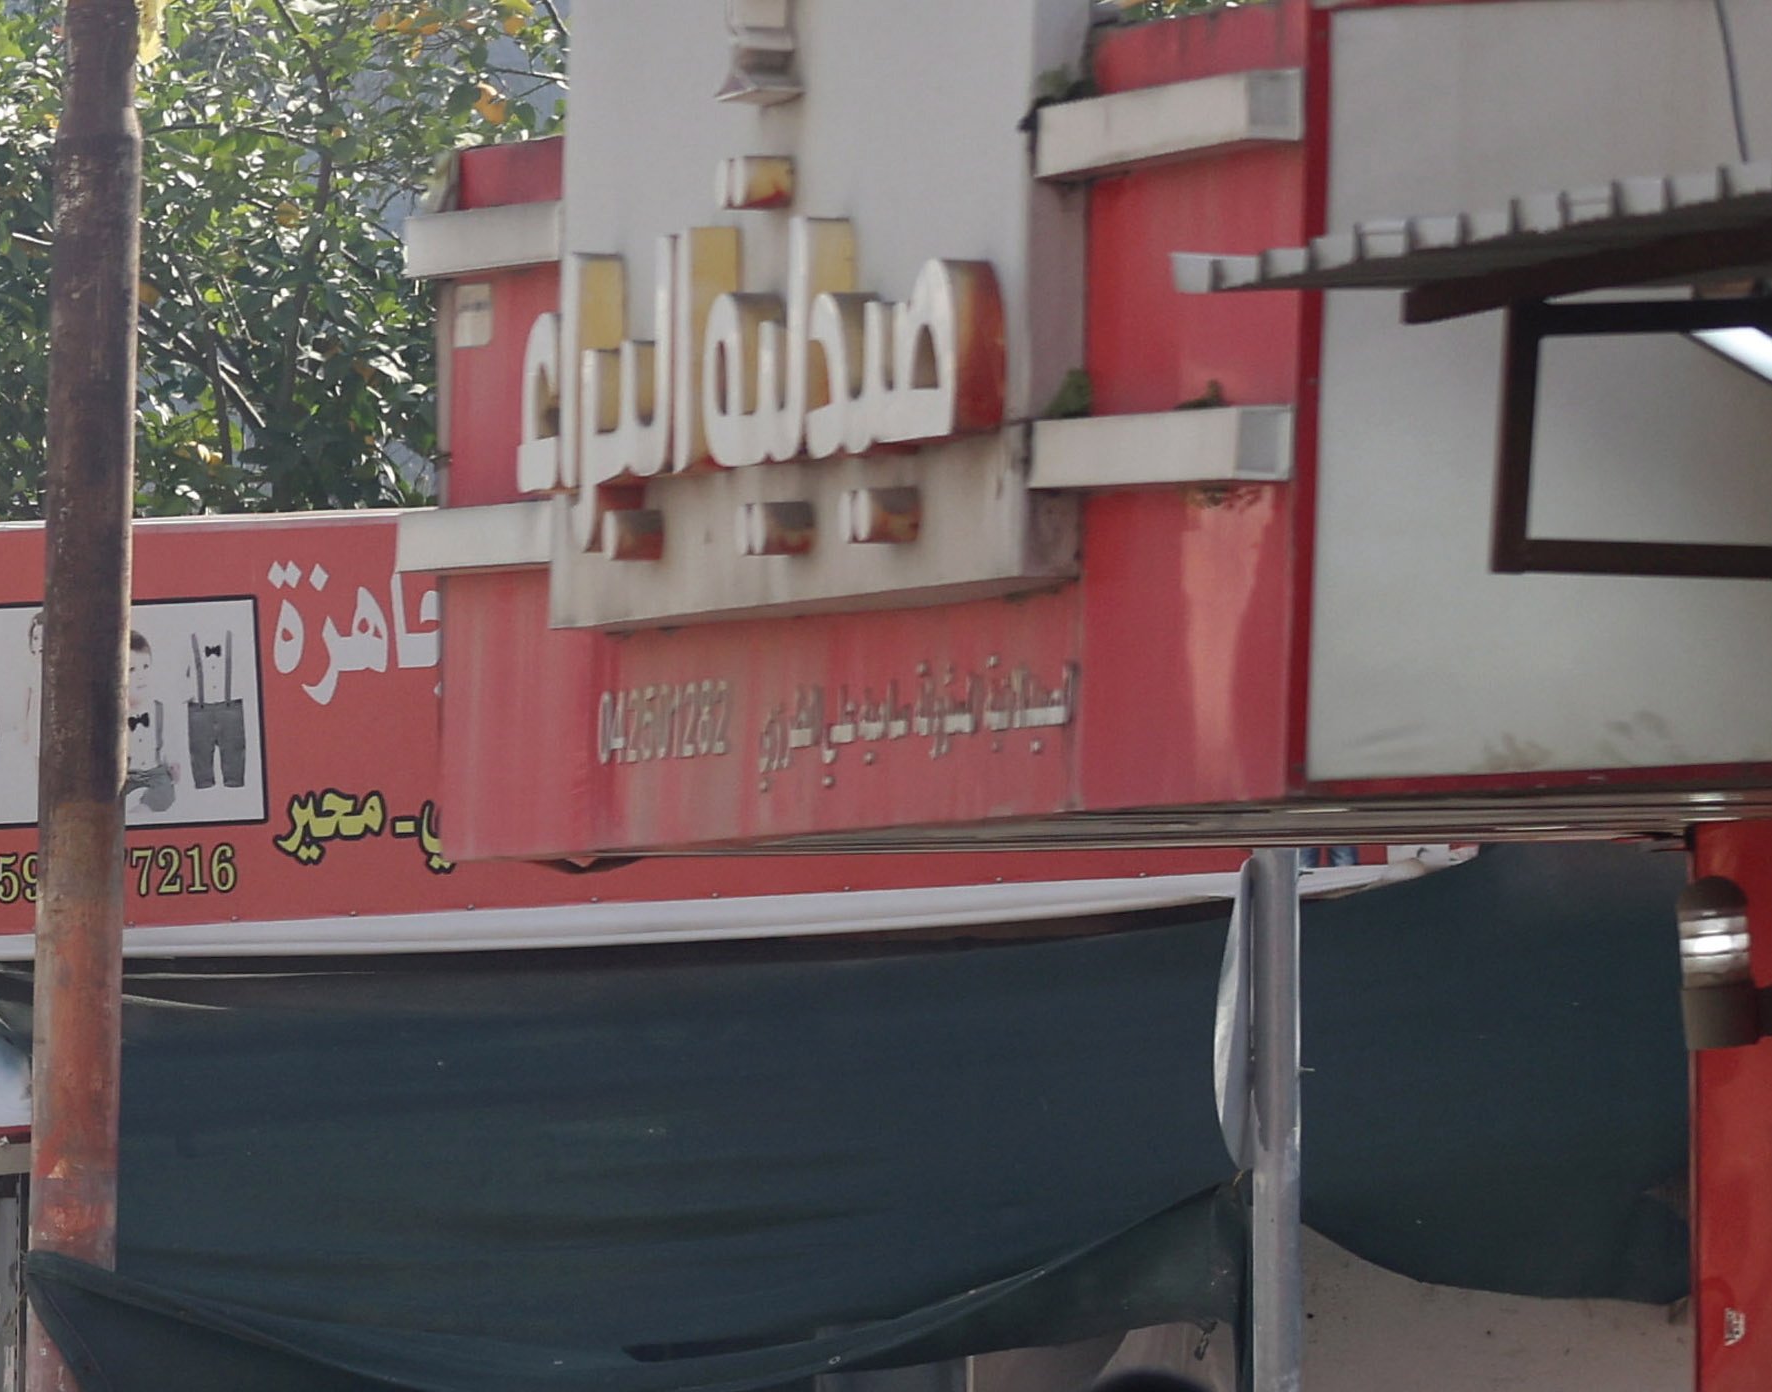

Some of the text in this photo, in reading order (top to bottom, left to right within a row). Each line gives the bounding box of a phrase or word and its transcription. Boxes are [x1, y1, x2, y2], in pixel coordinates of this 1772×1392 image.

[517, 156, 1005, 562] صيدلية البراء
[267, 559, 441, 705] اهزة
